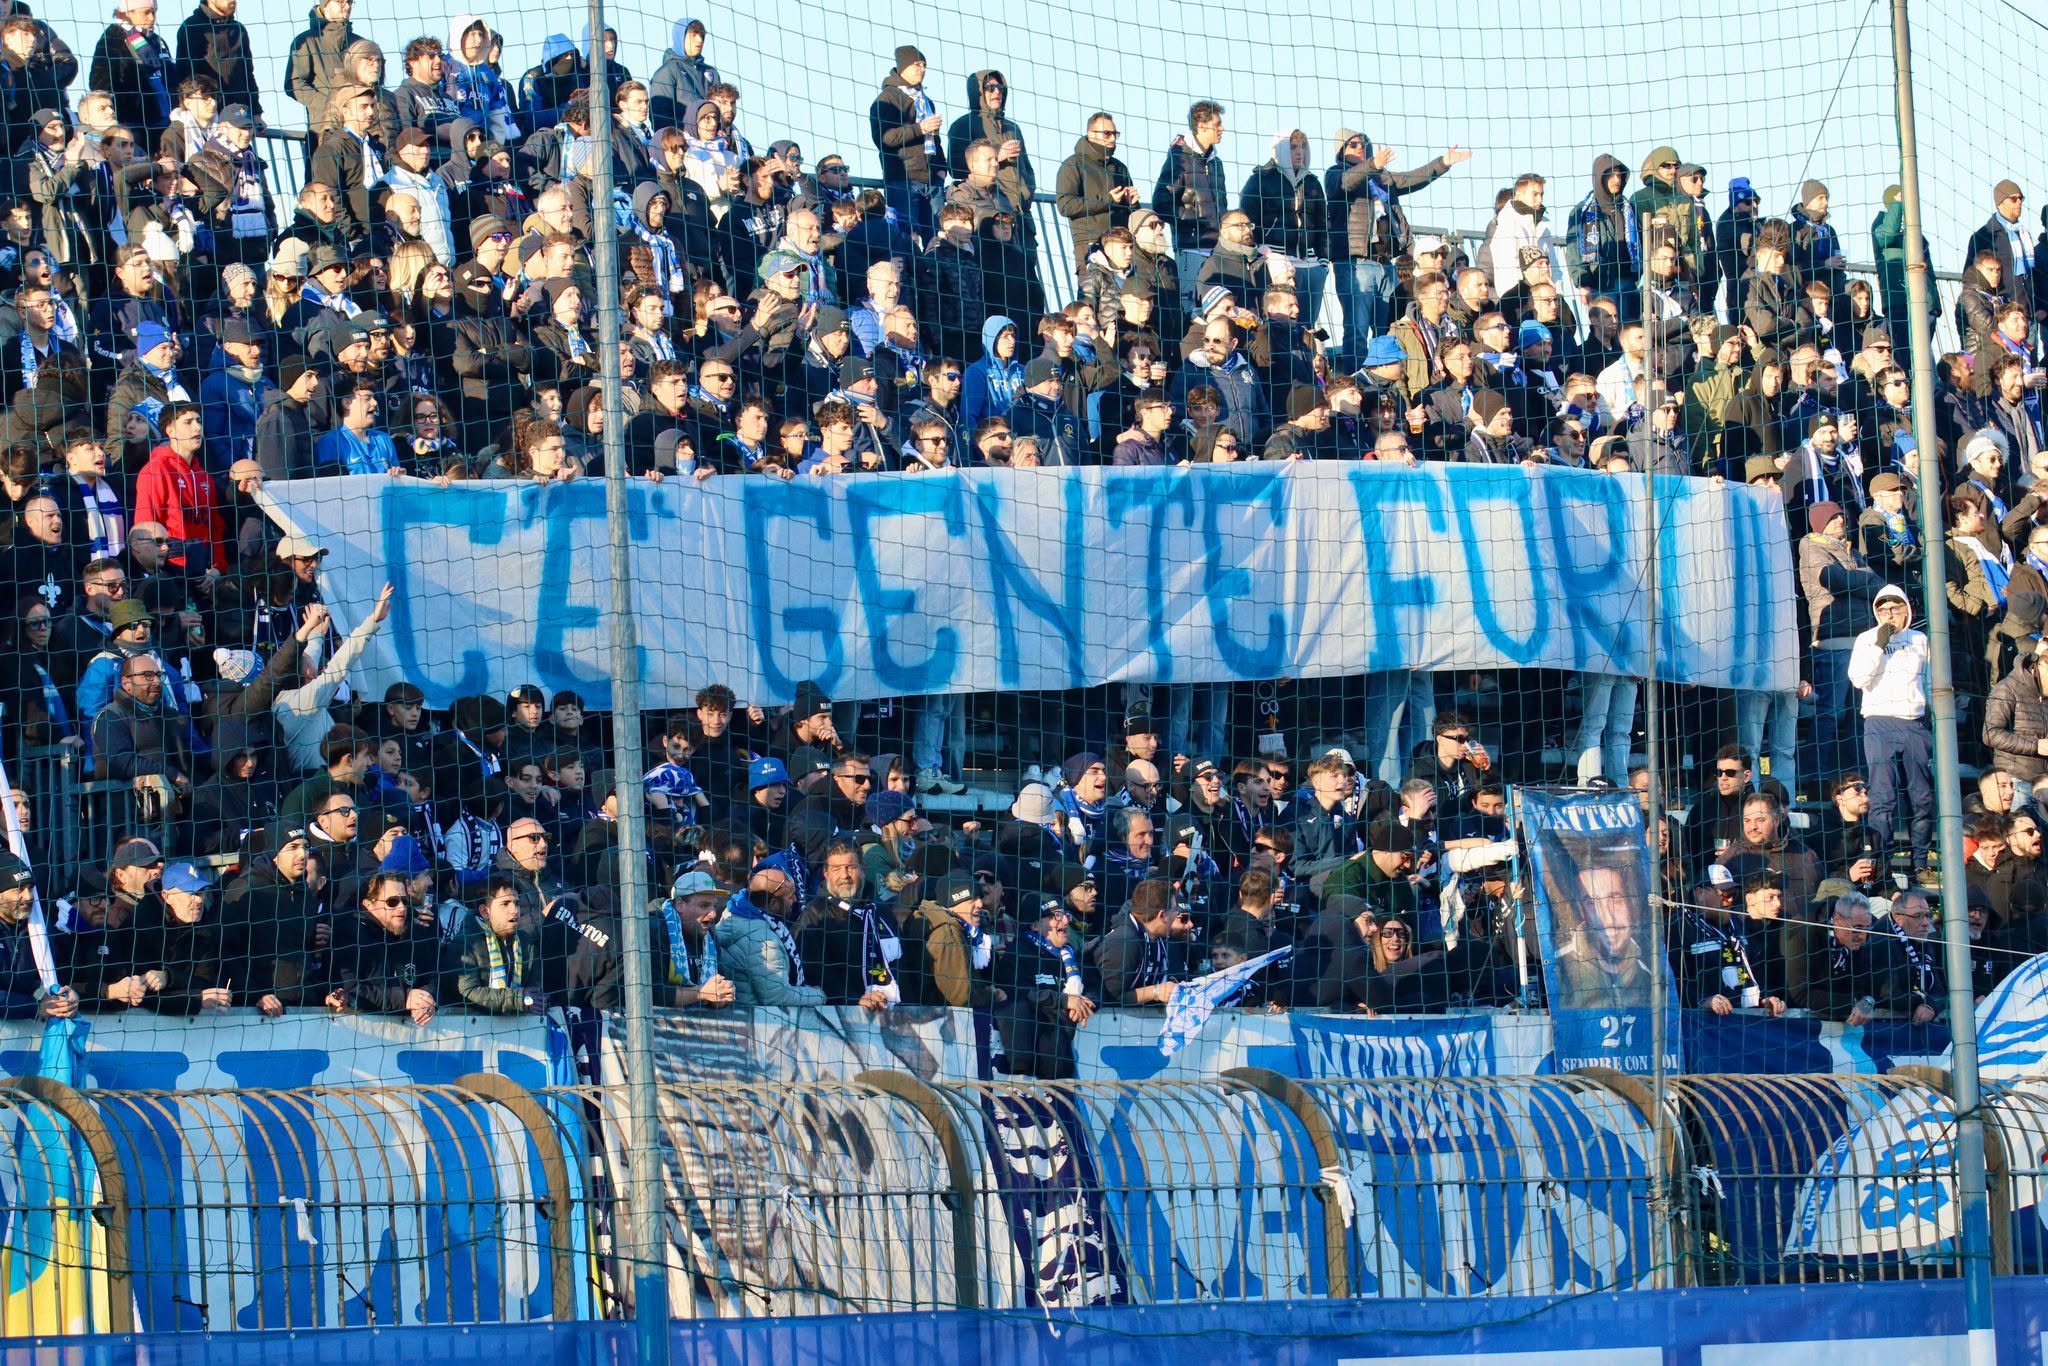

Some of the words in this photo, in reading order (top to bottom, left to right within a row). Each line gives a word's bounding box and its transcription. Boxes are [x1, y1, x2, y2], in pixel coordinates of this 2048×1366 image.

[744, 470, 1288, 697] GENTE
[1599, 1014, 1637, 1049] 27
[1624, 1055, 1649, 1072] CON
